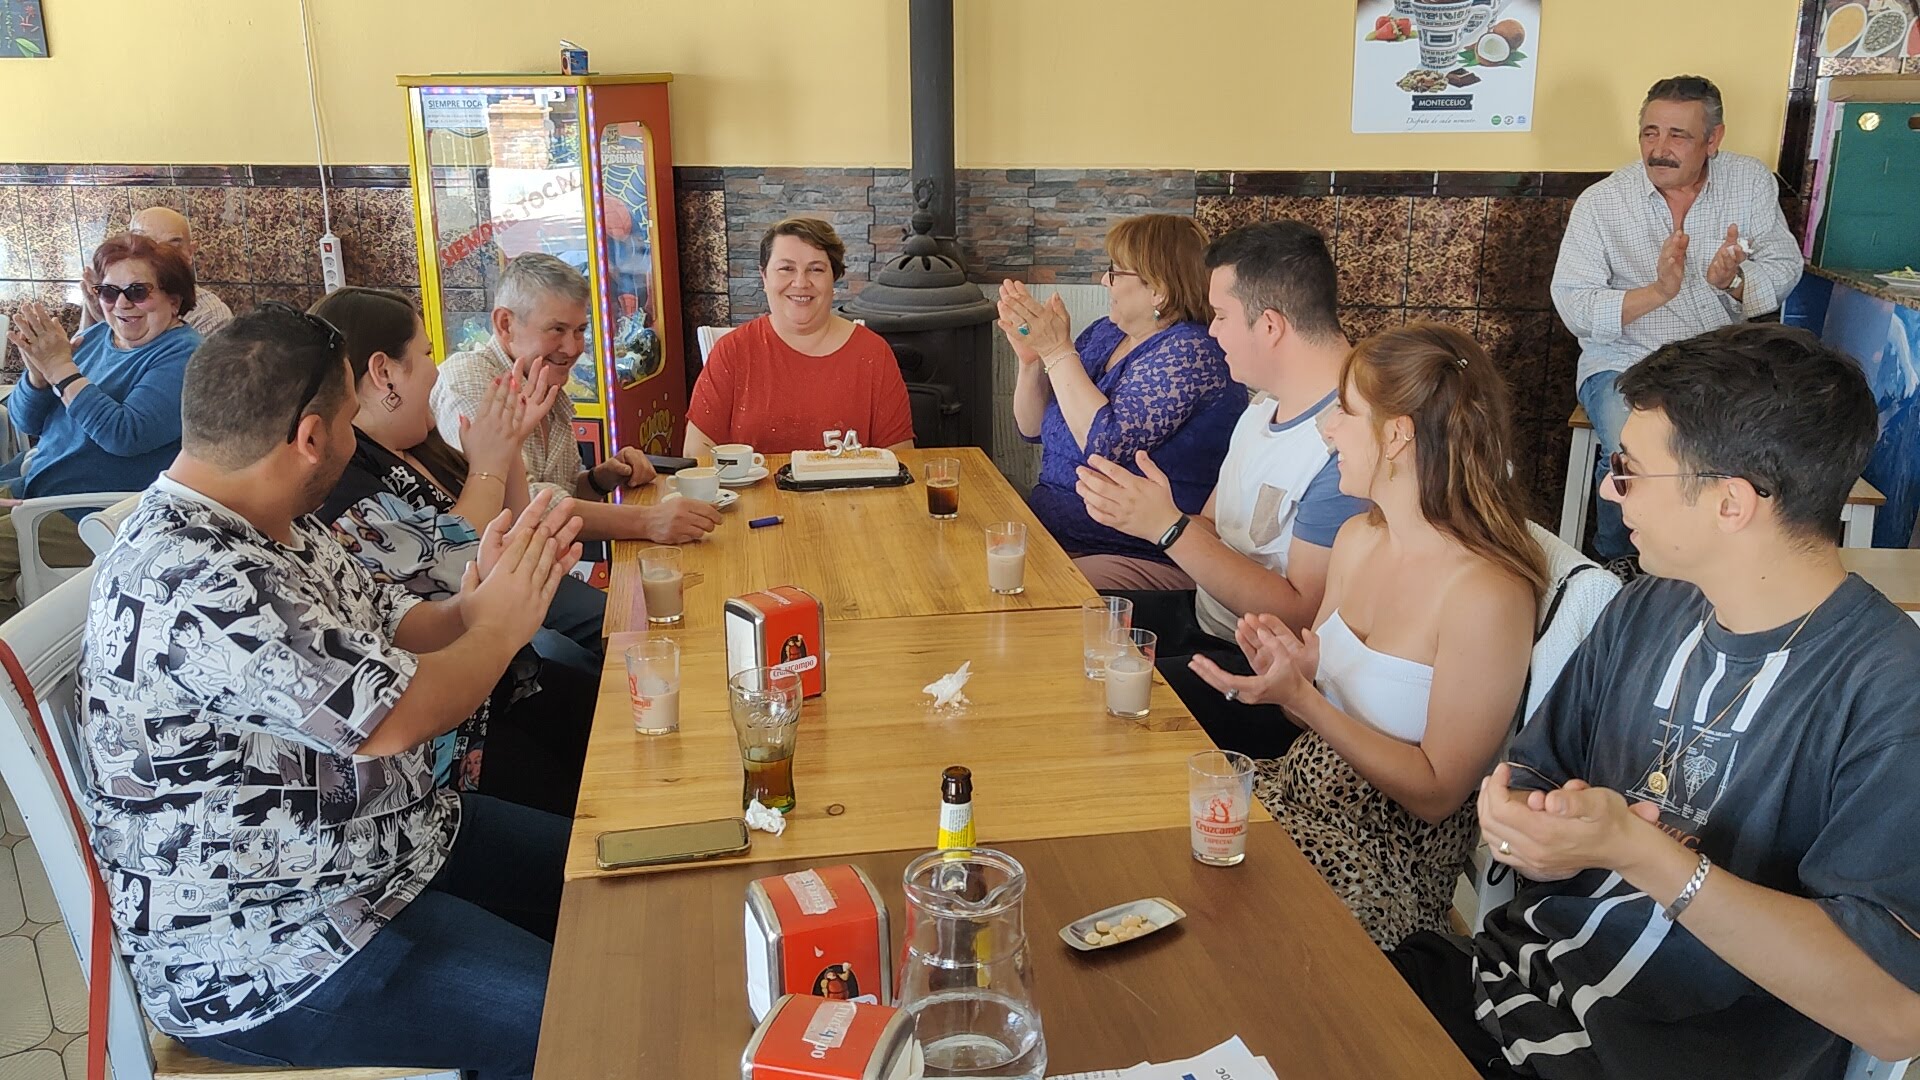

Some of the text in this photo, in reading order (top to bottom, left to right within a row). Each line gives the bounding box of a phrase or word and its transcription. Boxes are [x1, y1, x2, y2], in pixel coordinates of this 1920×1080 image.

[428, 99, 483, 108] SIEMPRE TOCA
[1418, 98, 1467, 107] MONTECELIO
[822, 429, 862, 457] 54
[1196, 820, 1243, 836] Cruzcampo
[182, 888, 197, 901] 朝
